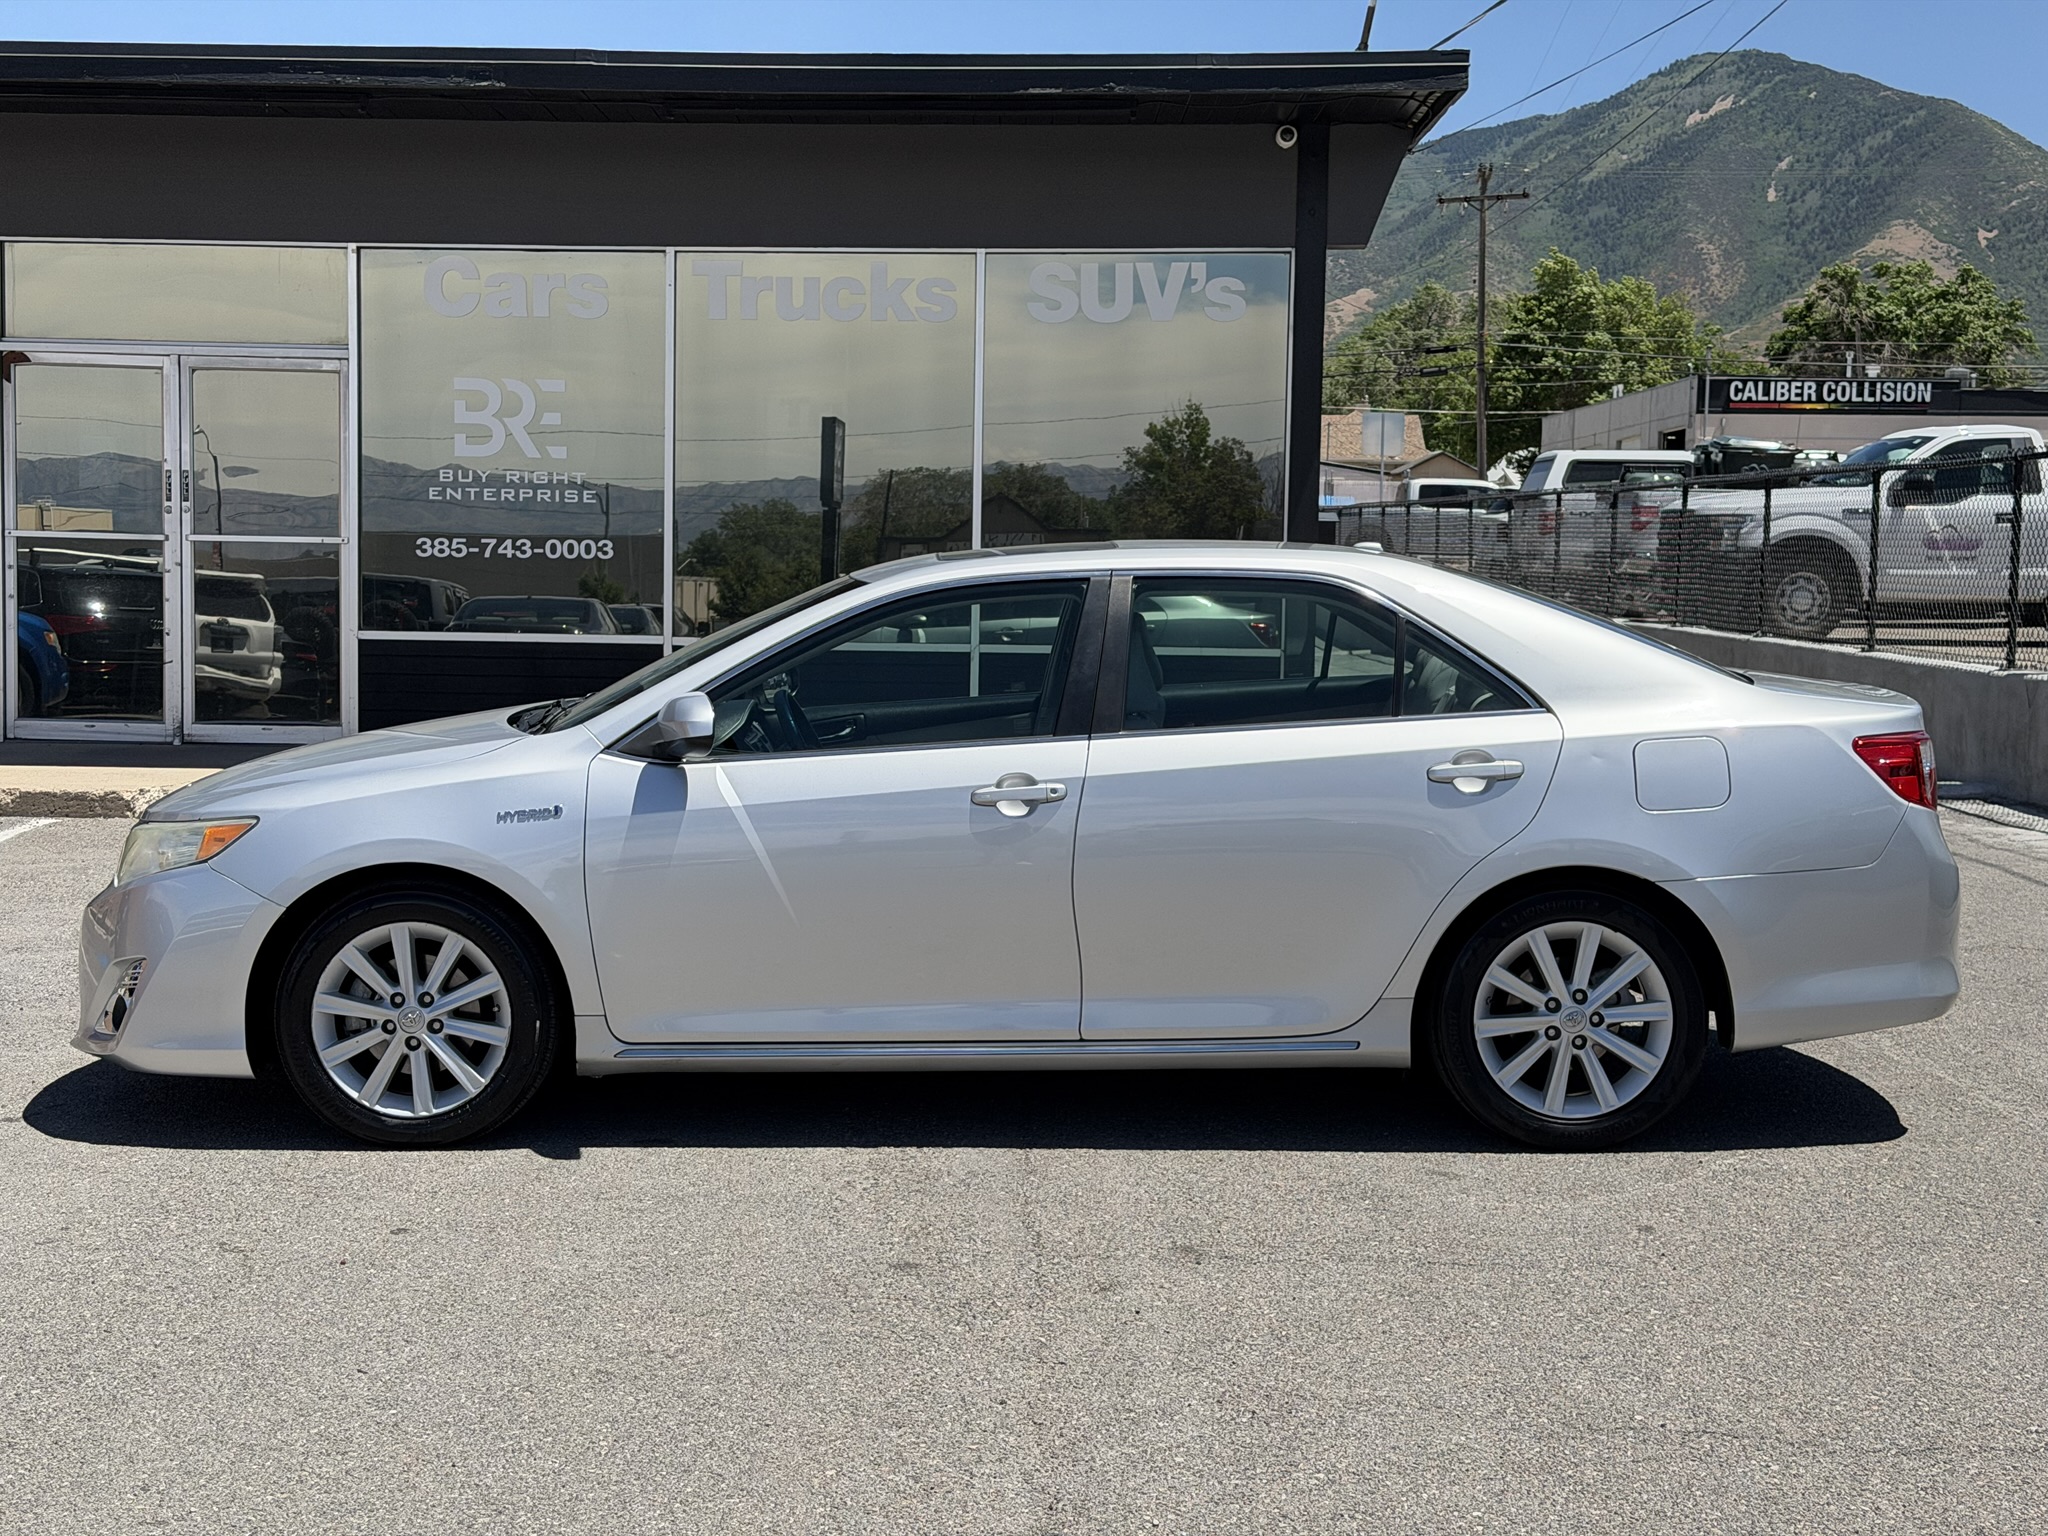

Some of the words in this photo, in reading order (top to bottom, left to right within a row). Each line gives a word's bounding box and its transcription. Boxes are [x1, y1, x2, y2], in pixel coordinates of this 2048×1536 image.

[423, 254, 609, 319] Cars
[691, 259, 958, 323] Trucks
[1026, 261, 1248, 324] SUV's
[1729, 380, 1817, 402] CALIBER
[1822, 381, 1932, 403] COLLISION
[453, 377, 568, 459] BRE
[439, 469, 491, 483] BUY
[506, 470, 586, 485] RIGHT
[428, 487, 597, 503] ENTERPRISE
[415, 537, 614, 560] 385-743-0003
[496, 807, 553, 825] HYBRID
